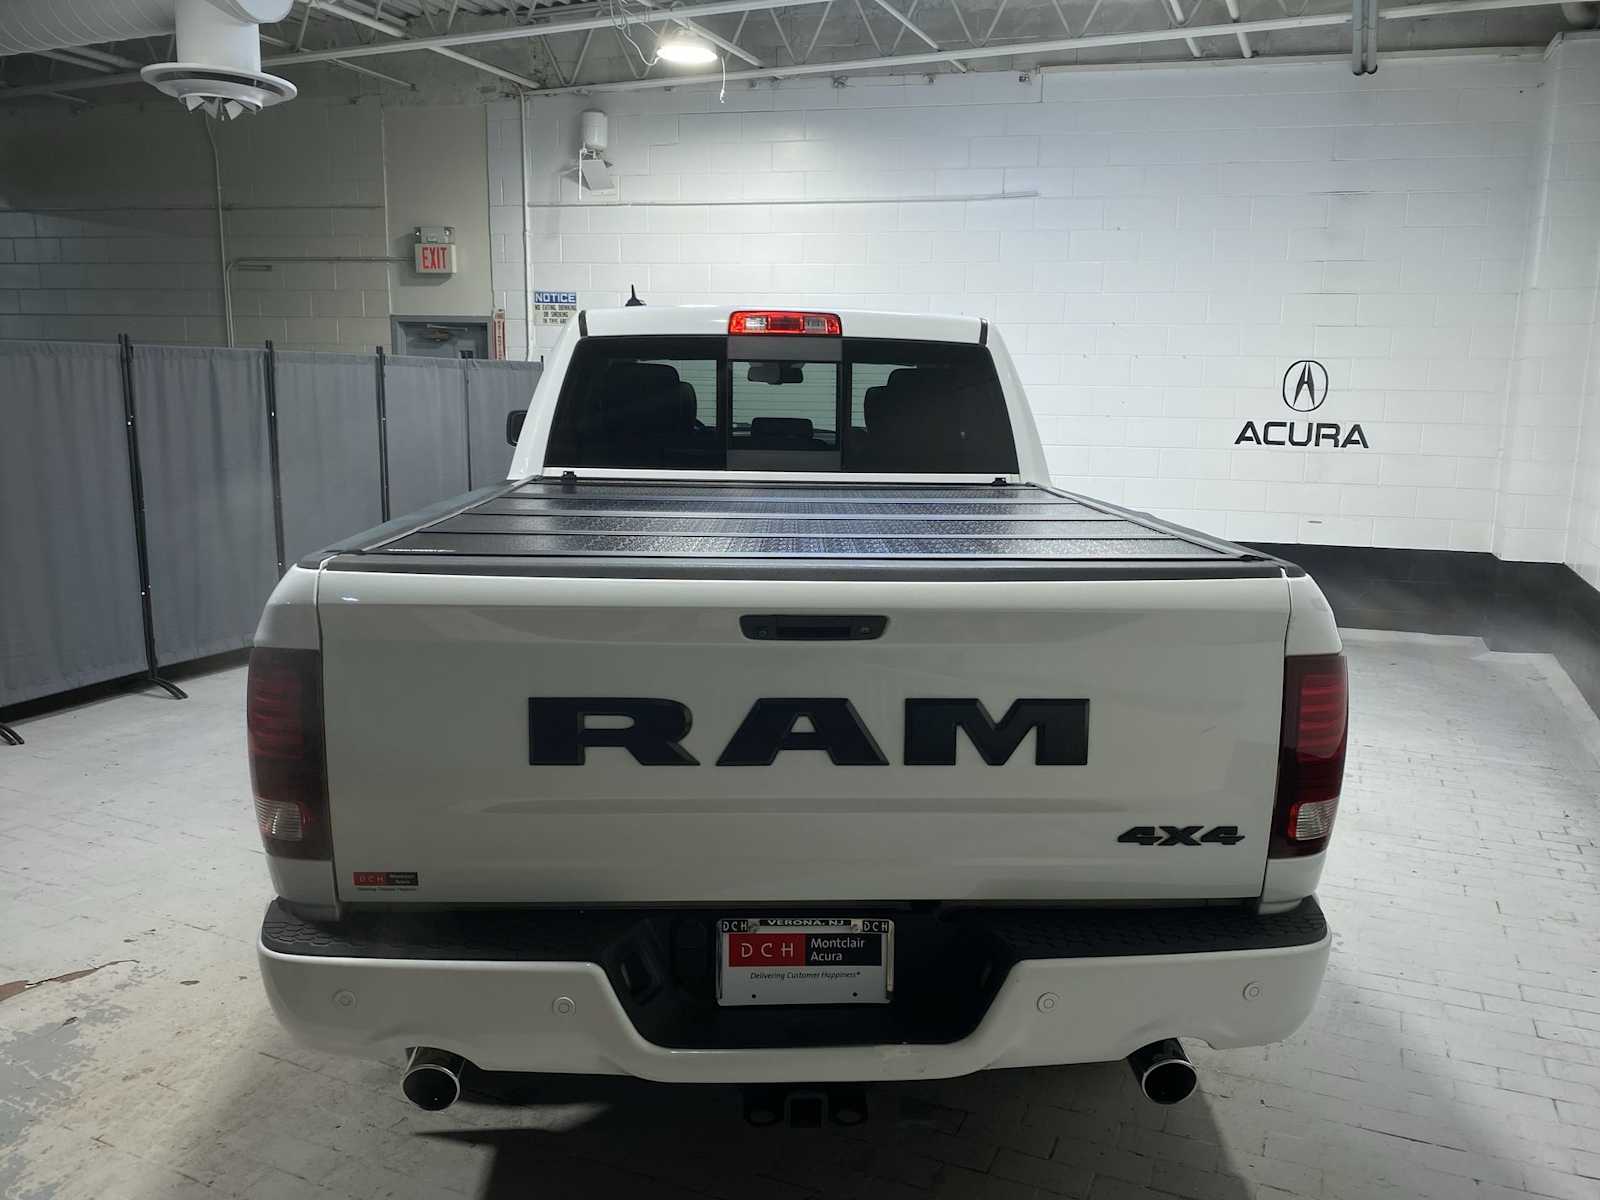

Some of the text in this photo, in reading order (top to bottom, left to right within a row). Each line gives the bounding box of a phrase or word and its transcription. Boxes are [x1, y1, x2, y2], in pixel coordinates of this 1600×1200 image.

[422, 247, 448, 270] EXIT
[535, 292, 576, 303] NOTICE
[1234, 421, 1369, 449] ACURA
[528, 696, 1091, 766] RAM
[1117, 825, 1246, 846] 4X4
[722, 921, 748, 932] DCH
[863, 921, 888, 932] DCH
[810, 937, 865, 949] Montclair
[810, 951, 843, 962] Acura
[750, 971, 785, 980] Delivering
[787, 971, 820, 979] Customer
